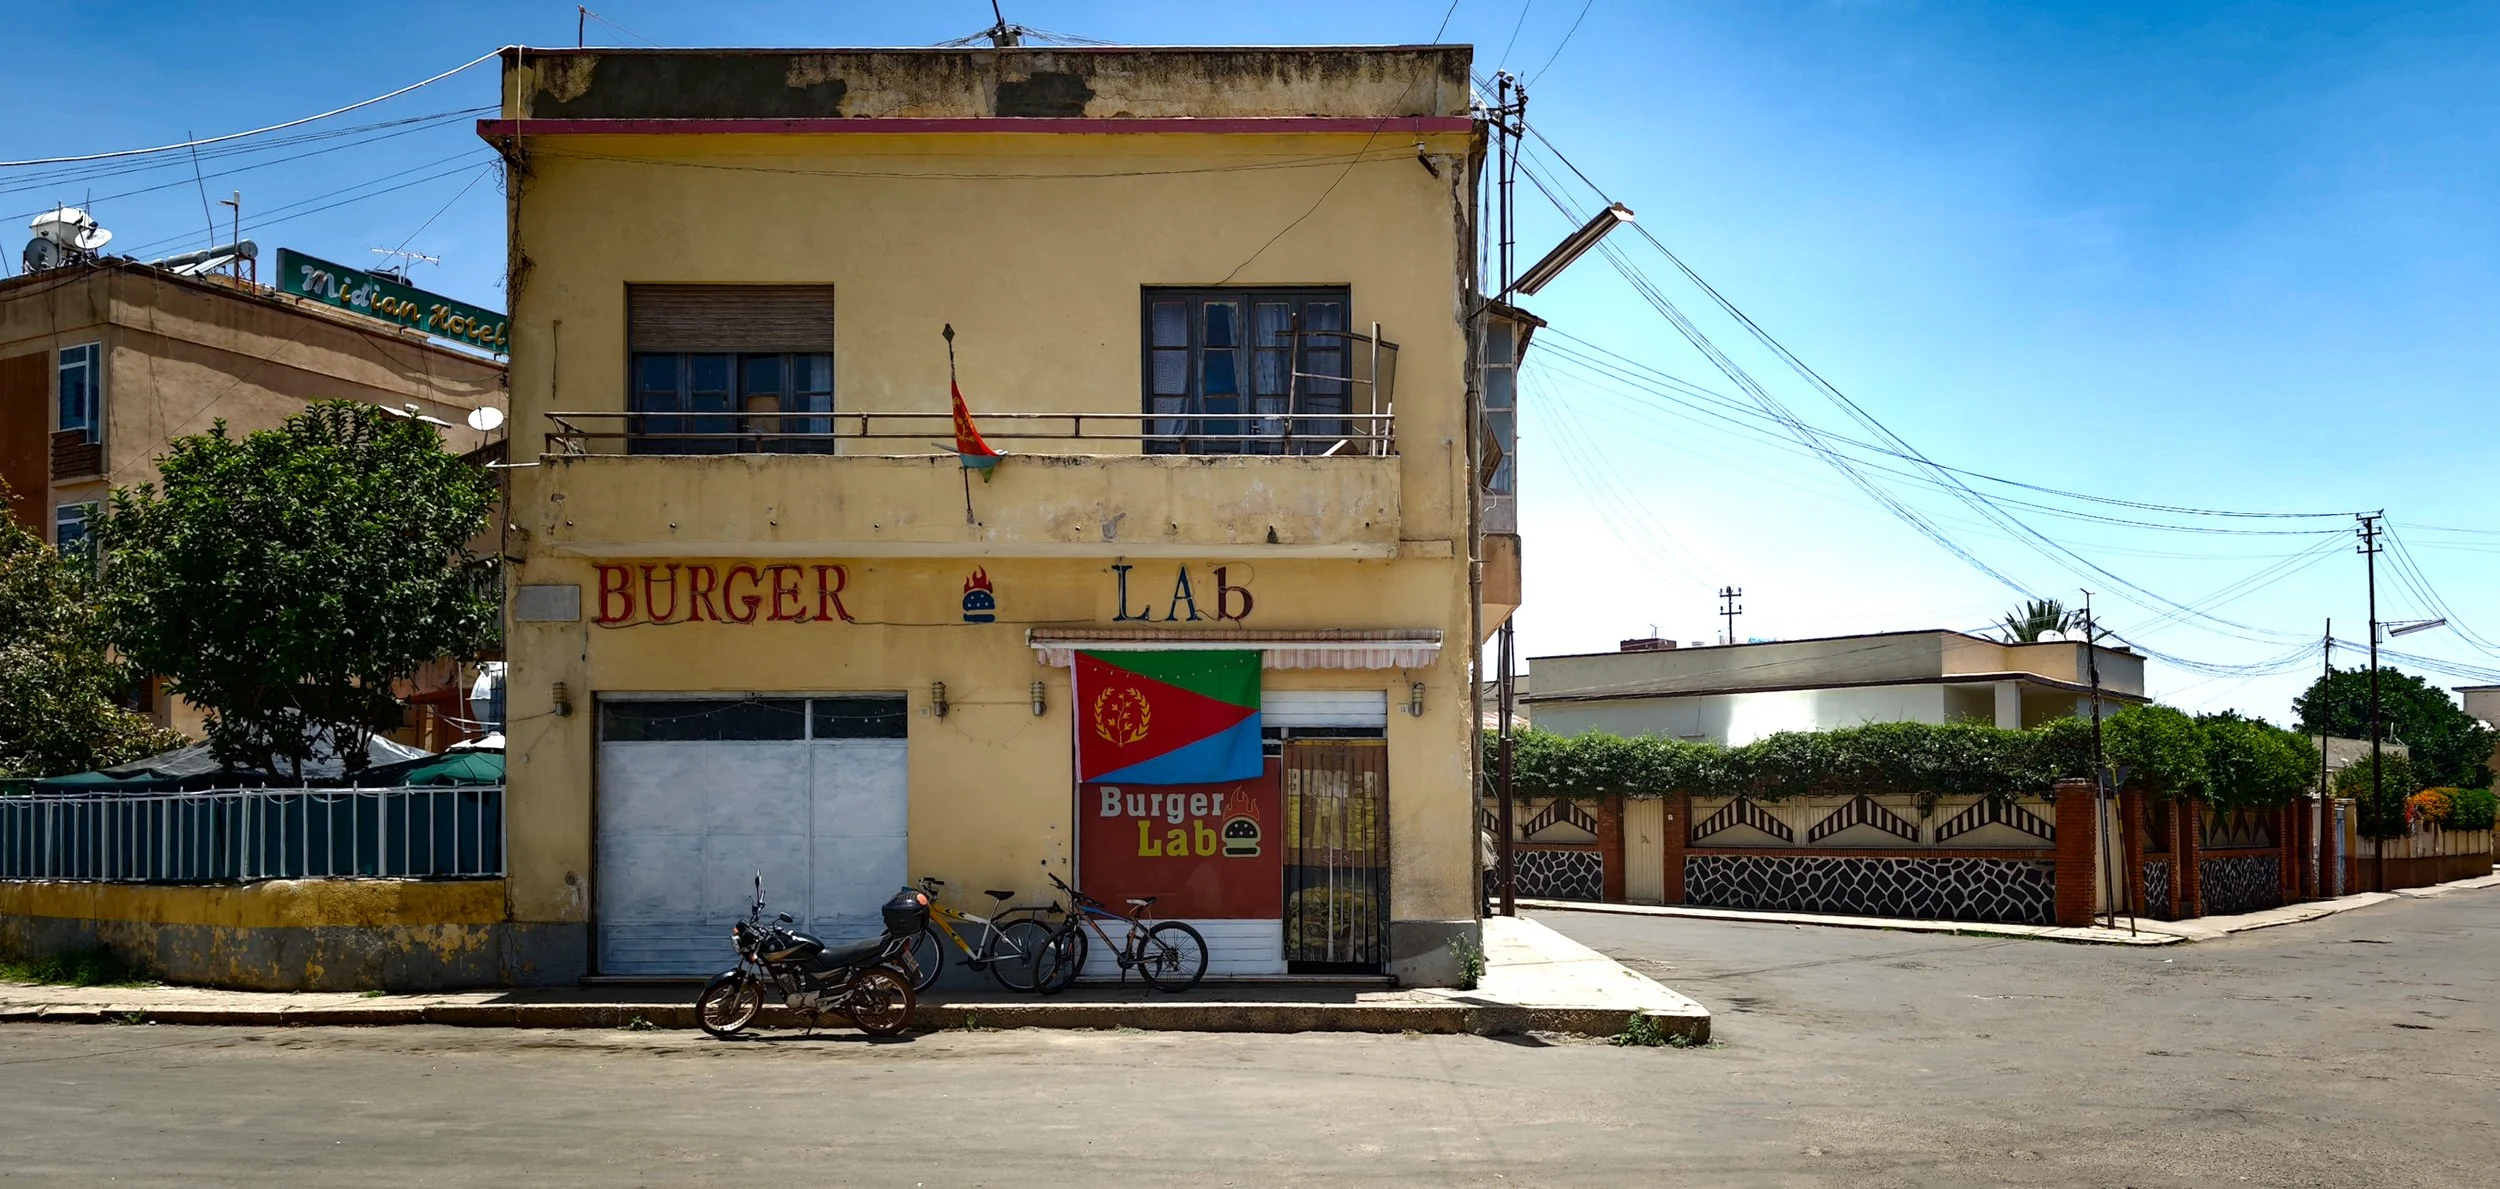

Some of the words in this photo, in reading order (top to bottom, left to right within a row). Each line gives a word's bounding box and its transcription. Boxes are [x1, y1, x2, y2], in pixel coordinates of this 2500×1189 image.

[301, 264, 421, 321] Midian
[429, 303, 507, 346] Hotel
[594, 562, 854, 624] BURGER
[1100, 786, 1224, 824] Burger
[1138, 819, 1217, 857] Lab
